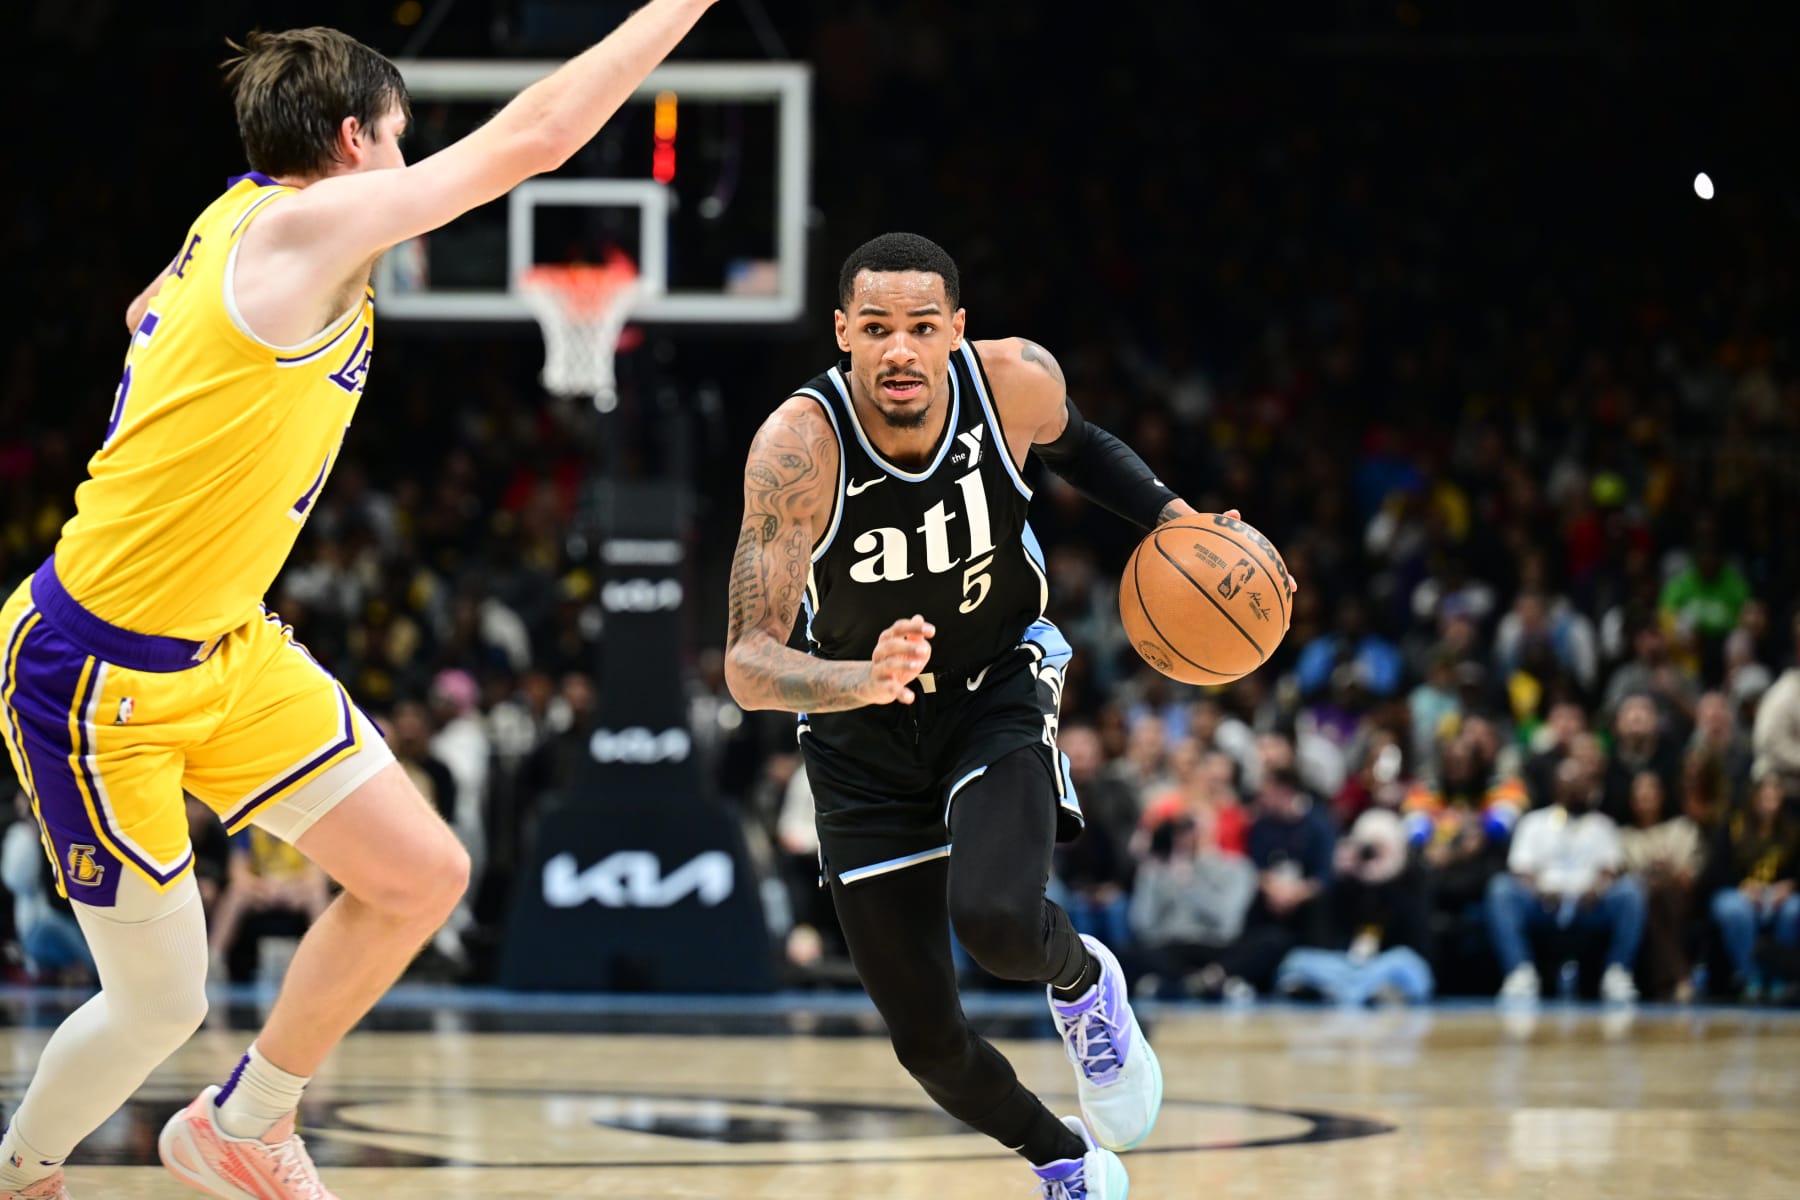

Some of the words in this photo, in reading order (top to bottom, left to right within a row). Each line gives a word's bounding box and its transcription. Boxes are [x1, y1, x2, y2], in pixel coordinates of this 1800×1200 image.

[951, 451, 967, 464] the
[849, 467, 997, 584] atl
[958, 554, 994, 614] 5
